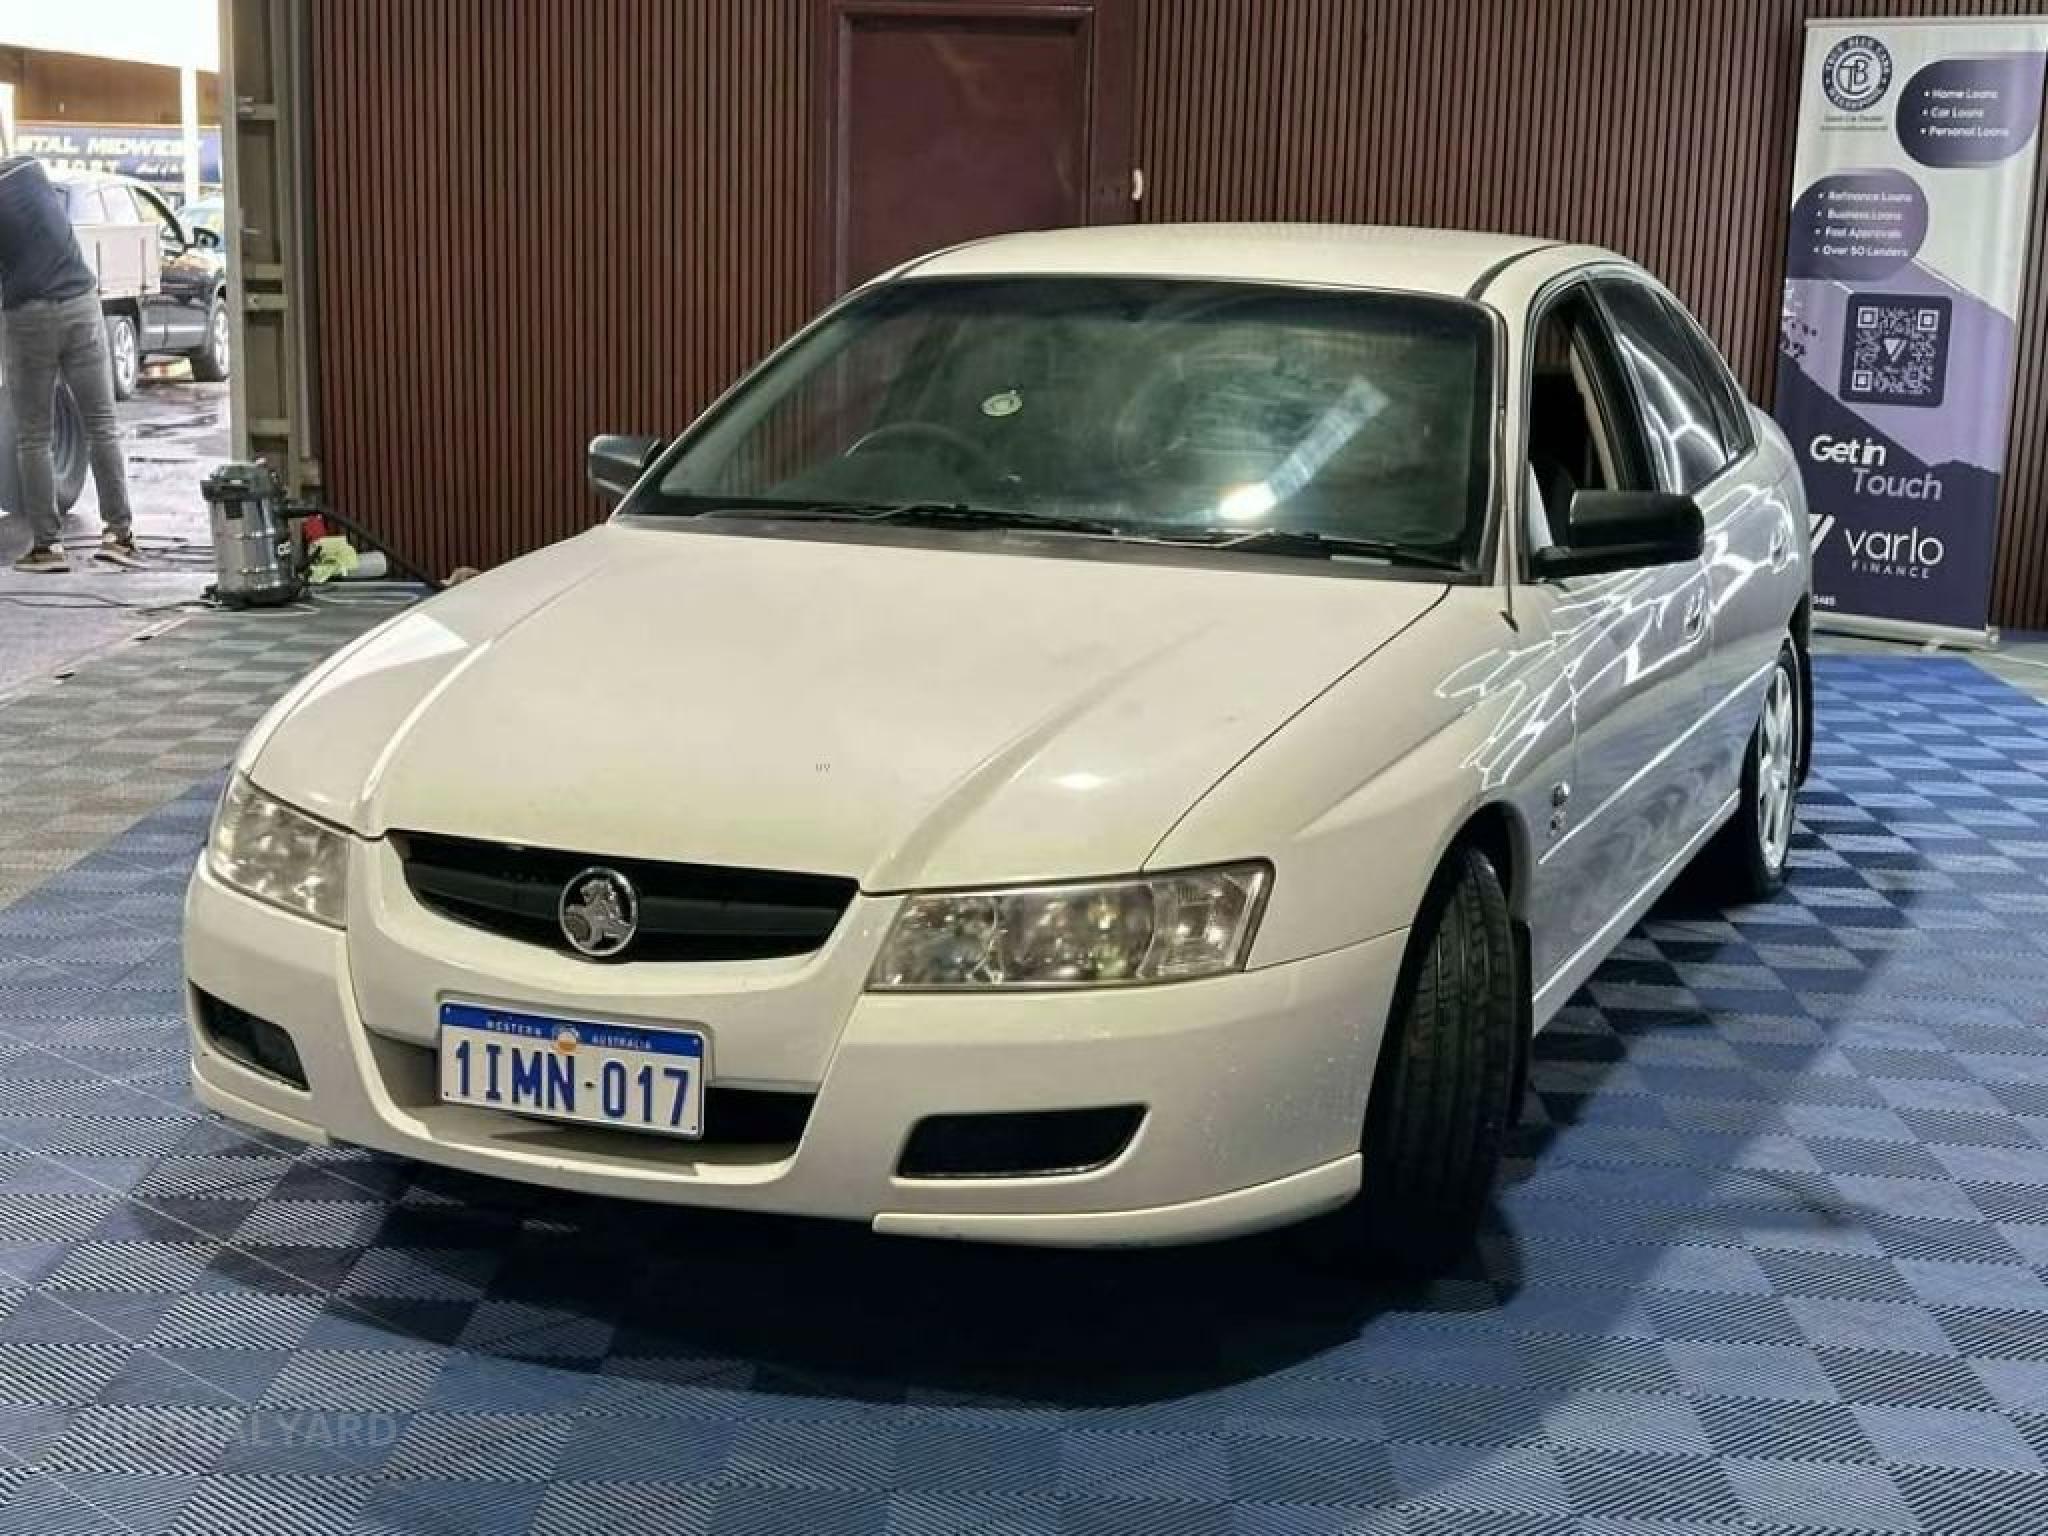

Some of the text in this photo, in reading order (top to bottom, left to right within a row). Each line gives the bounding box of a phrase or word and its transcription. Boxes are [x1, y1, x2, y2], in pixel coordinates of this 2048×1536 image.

[1932, 88, 1999, 99] Home Loans
[1931, 107, 1984, 119] Car Loans
[1929, 126, 2009, 137] Personal Loans
[1827, 191, 1913, 203] Refinance Loans
[1827, 208, 1903, 221] Business Loans
[1825, 226, 1903, 240] Fast Approvals
[1823, 244, 1909, 257] Over 50 Lenders
[1810, 434, 1887, 467] Get in
[1852, 467, 1943, 500] Touch
[1844, 526, 1944, 566] varlo
[1851, 560, 1930, 579] FINANCE
